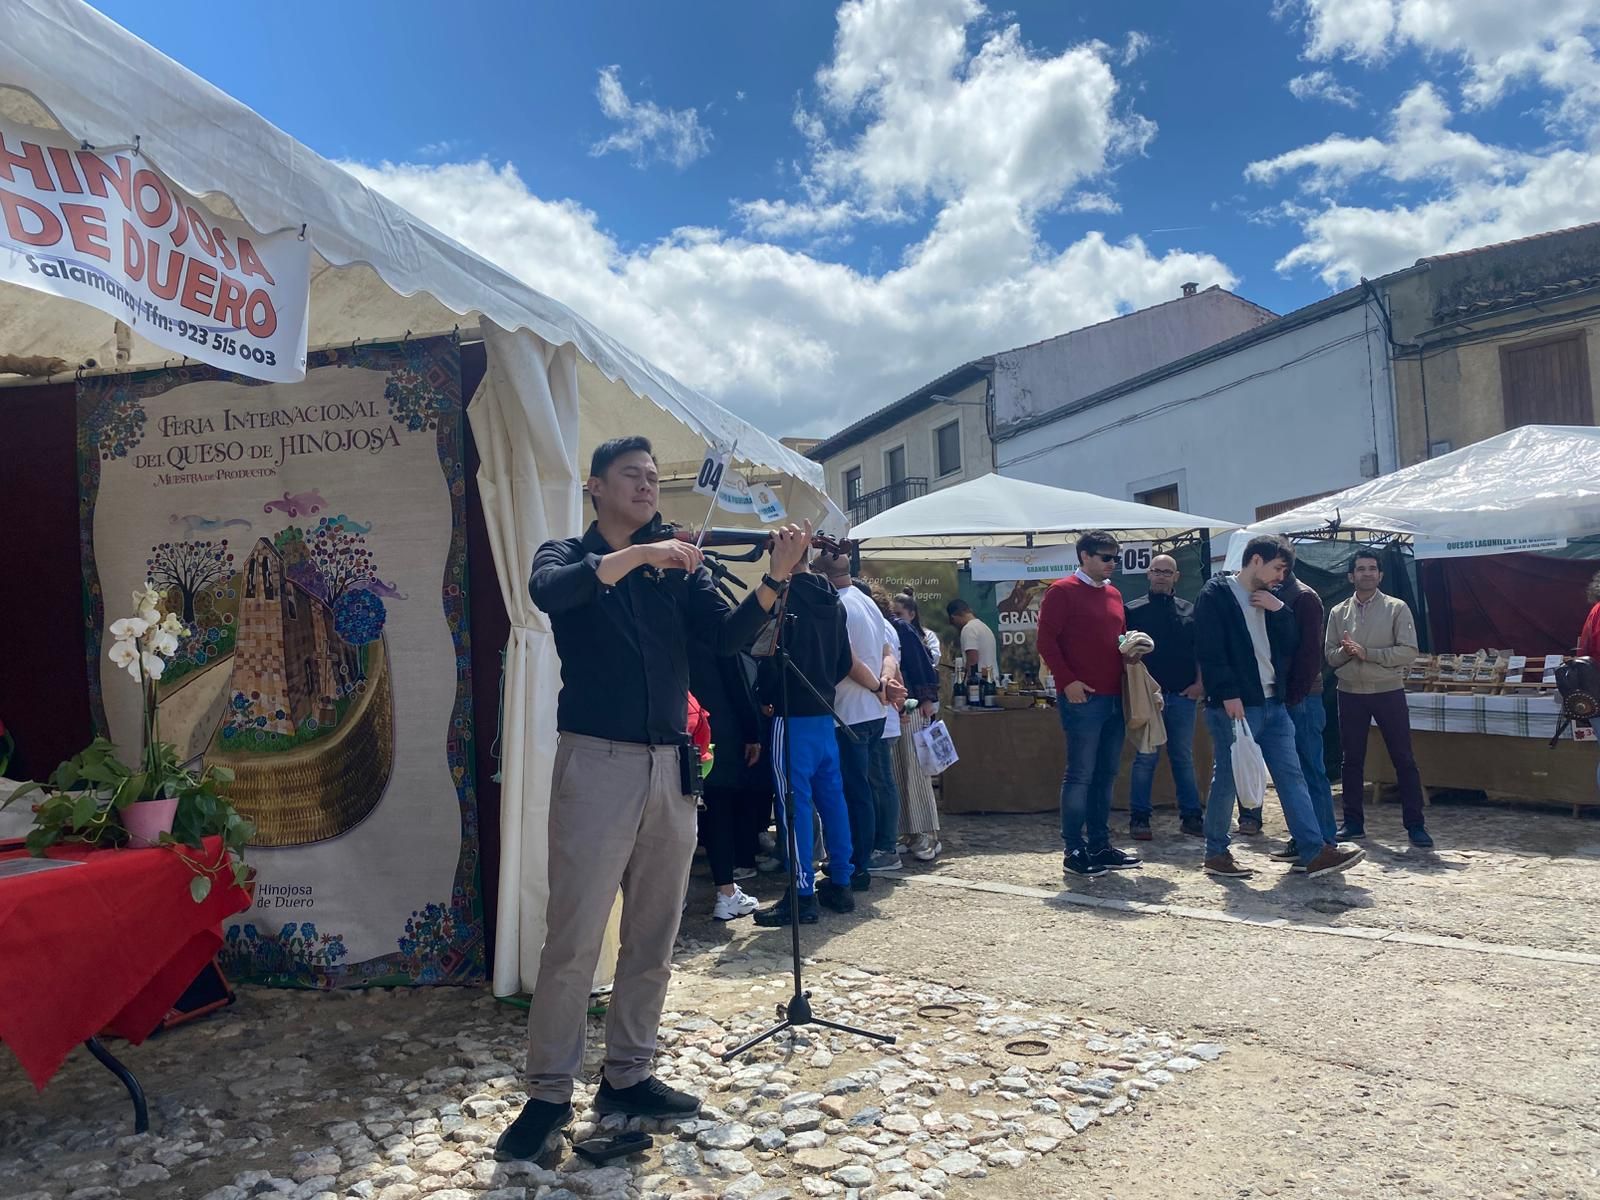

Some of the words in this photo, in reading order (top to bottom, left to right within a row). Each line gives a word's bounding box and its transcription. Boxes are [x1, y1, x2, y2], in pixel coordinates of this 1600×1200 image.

[0, 131, 275, 285] HINOJOSA
[0, 188, 111, 262] DE
[123, 219, 278, 338] DUERO
[26, 254, 136, 309] Salamanca
[143, 300, 174, 333] Tfn:
[178, 322, 208, 346] 923
[212, 334, 236, 356] 515
[239, 344, 277, 366] 003
[166, 442, 244, 471] QUESO
[250, 445, 273, 459] DE
[698, 457, 724, 492] 04
[1446, 540, 1474, 550] QUESOS
[1125, 548, 1151, 570] 05
[886, 576, 922, 586] Portugal
[1002, 631, 1026, 646] DO
[258, 883, 314, 897] Hinojosa
[257, 896, 271, 909] de
[274, 895, 315, 909] Duero
